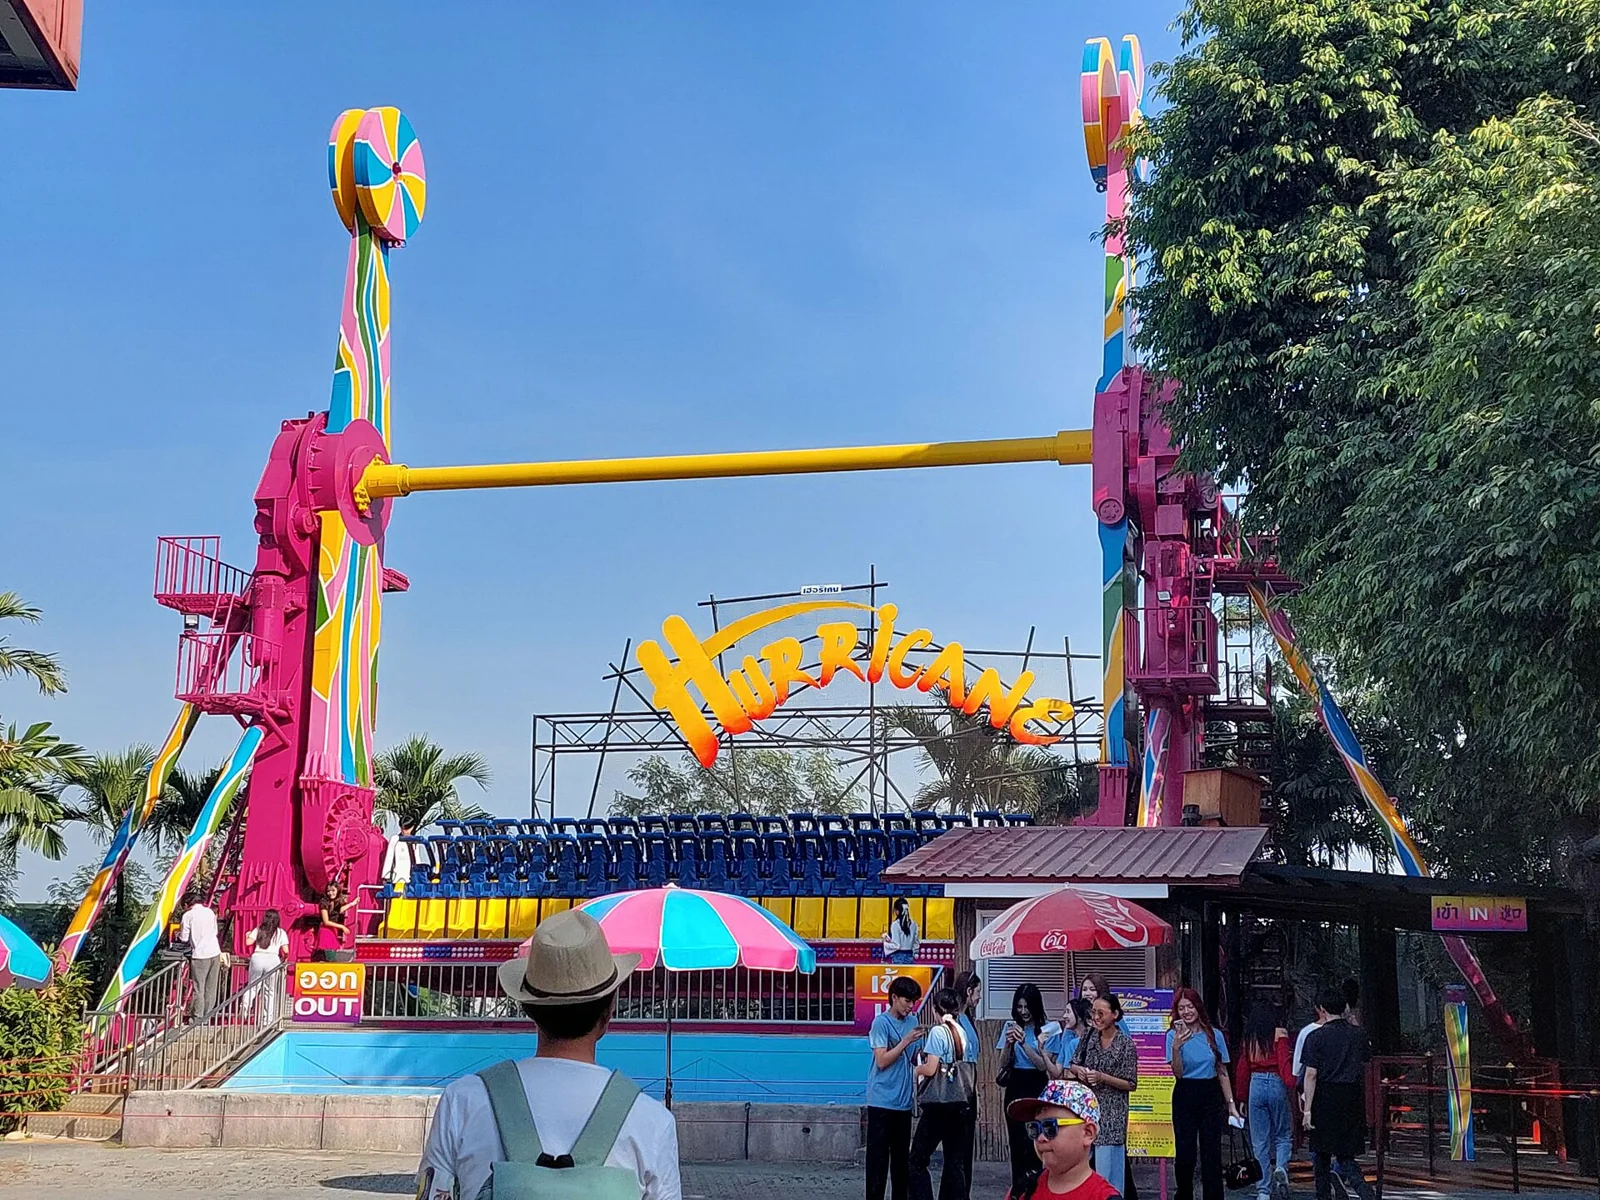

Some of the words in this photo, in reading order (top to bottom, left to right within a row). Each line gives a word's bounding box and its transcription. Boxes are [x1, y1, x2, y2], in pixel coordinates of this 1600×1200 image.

[1437, 902, 1458, 919] เข้า
[1469, 907, 1488, 921] IN
[300, 971, 357, 989] ออก
[295, 997, 359, 1016] OUT
